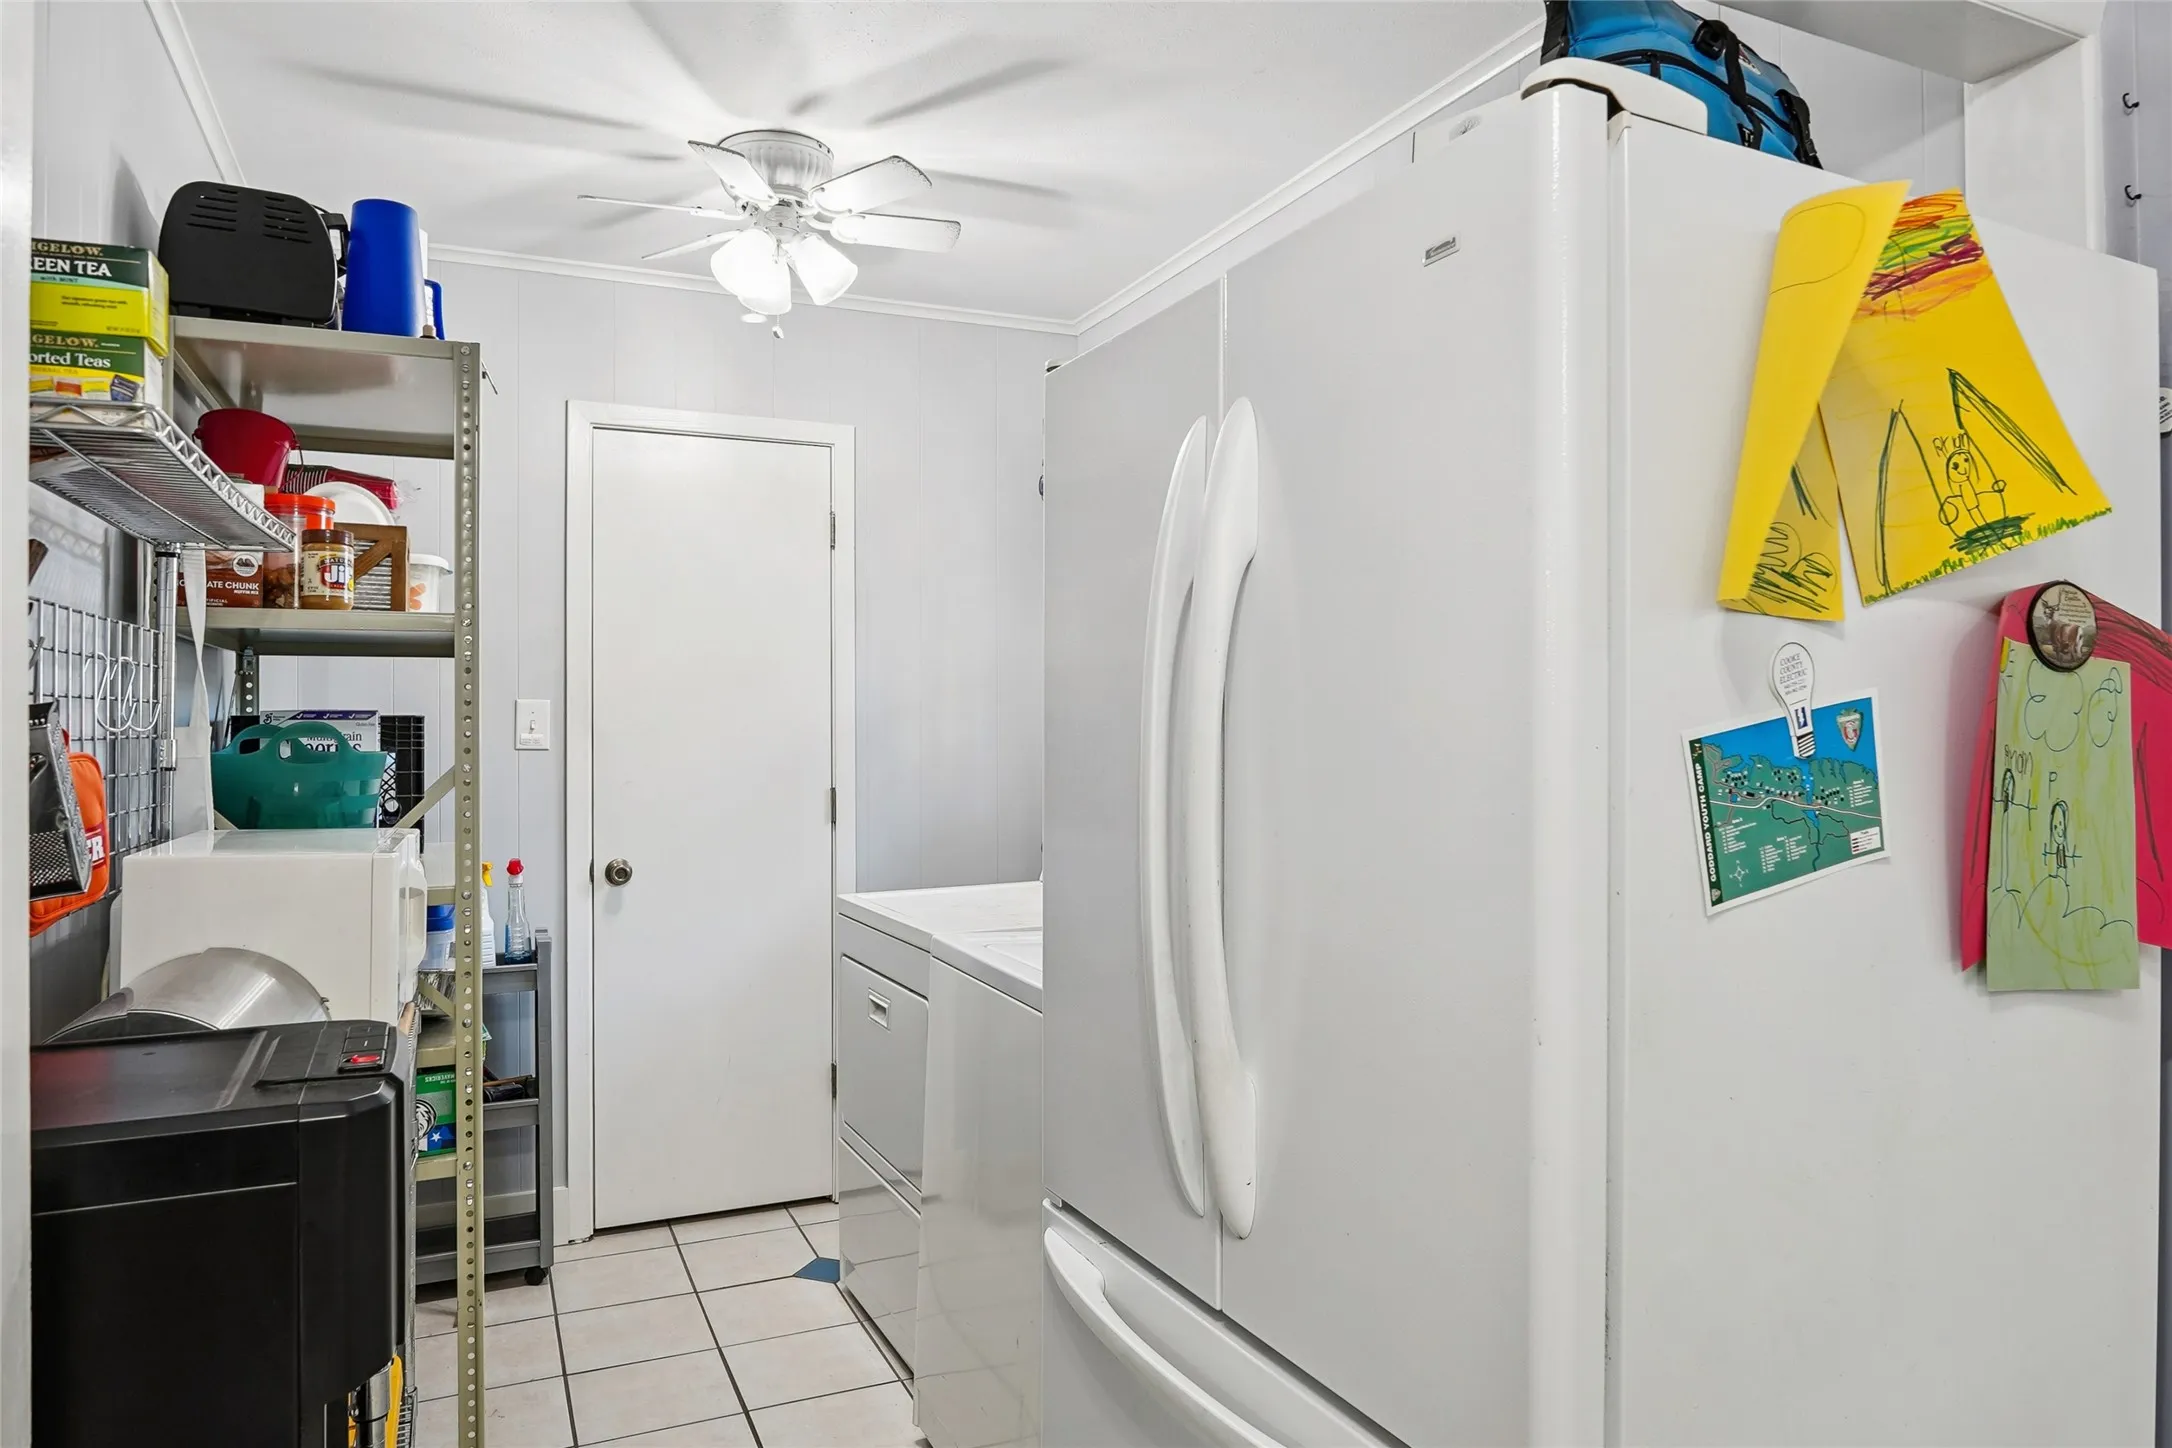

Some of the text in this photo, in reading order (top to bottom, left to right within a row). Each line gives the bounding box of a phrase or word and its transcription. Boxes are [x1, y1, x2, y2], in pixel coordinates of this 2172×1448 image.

[31, 240, 104, 257] IGELOW.
[74, 261, 113, 278] TEA
[32, 333, 99, 349] GELOW.
[29, 351, 112, 369] orted Teas
[323, 564, 349, 585] Ji
[224, 581, 260, 592] CHUNK
[1694, 763, 1717, 882] GODDARD YOUTH CAMP
